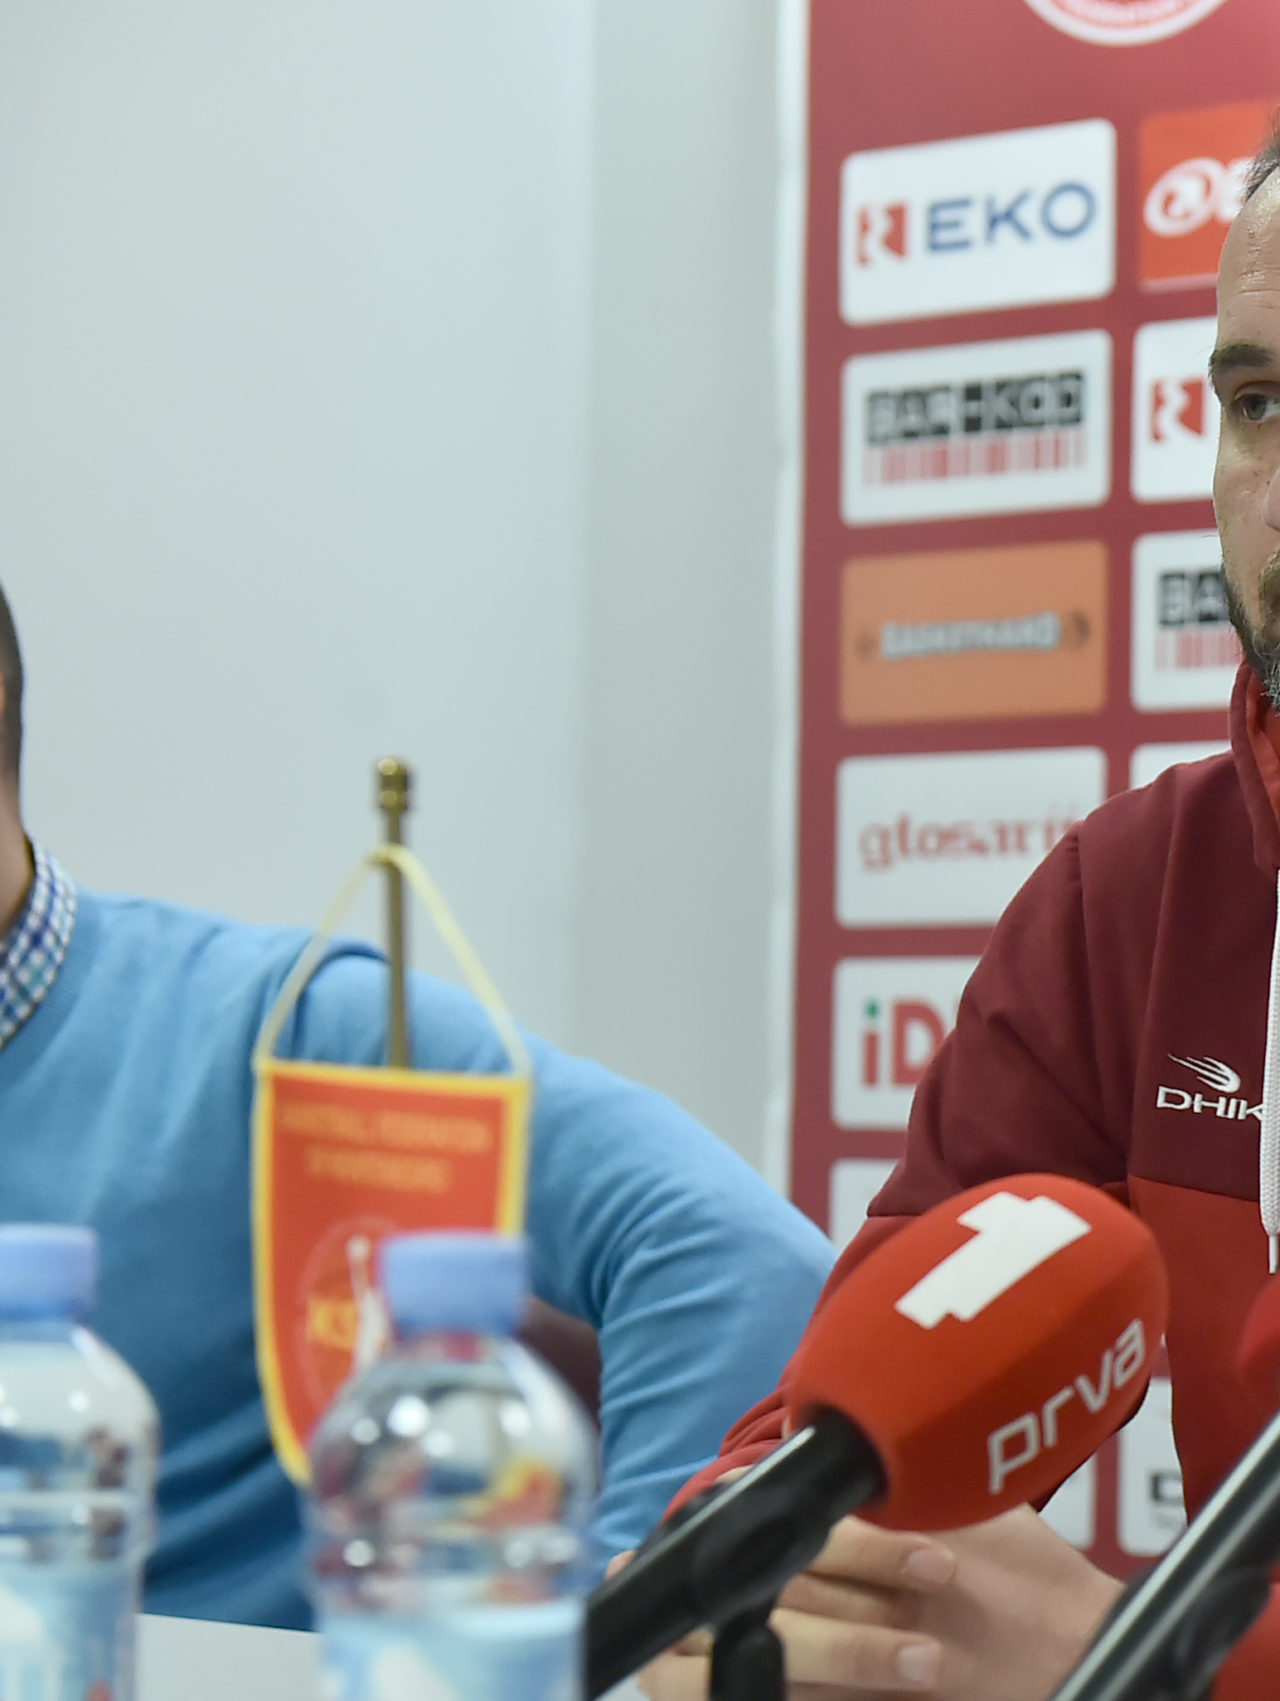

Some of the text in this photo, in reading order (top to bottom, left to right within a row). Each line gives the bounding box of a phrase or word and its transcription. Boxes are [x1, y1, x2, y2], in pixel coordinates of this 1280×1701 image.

[926, 182, 1097, 255] EKO
[858, 803, 1082, 873] glosari
[894, 1191, 1092, 1331] 1
[987, 1318, 1147, 1496] prva
